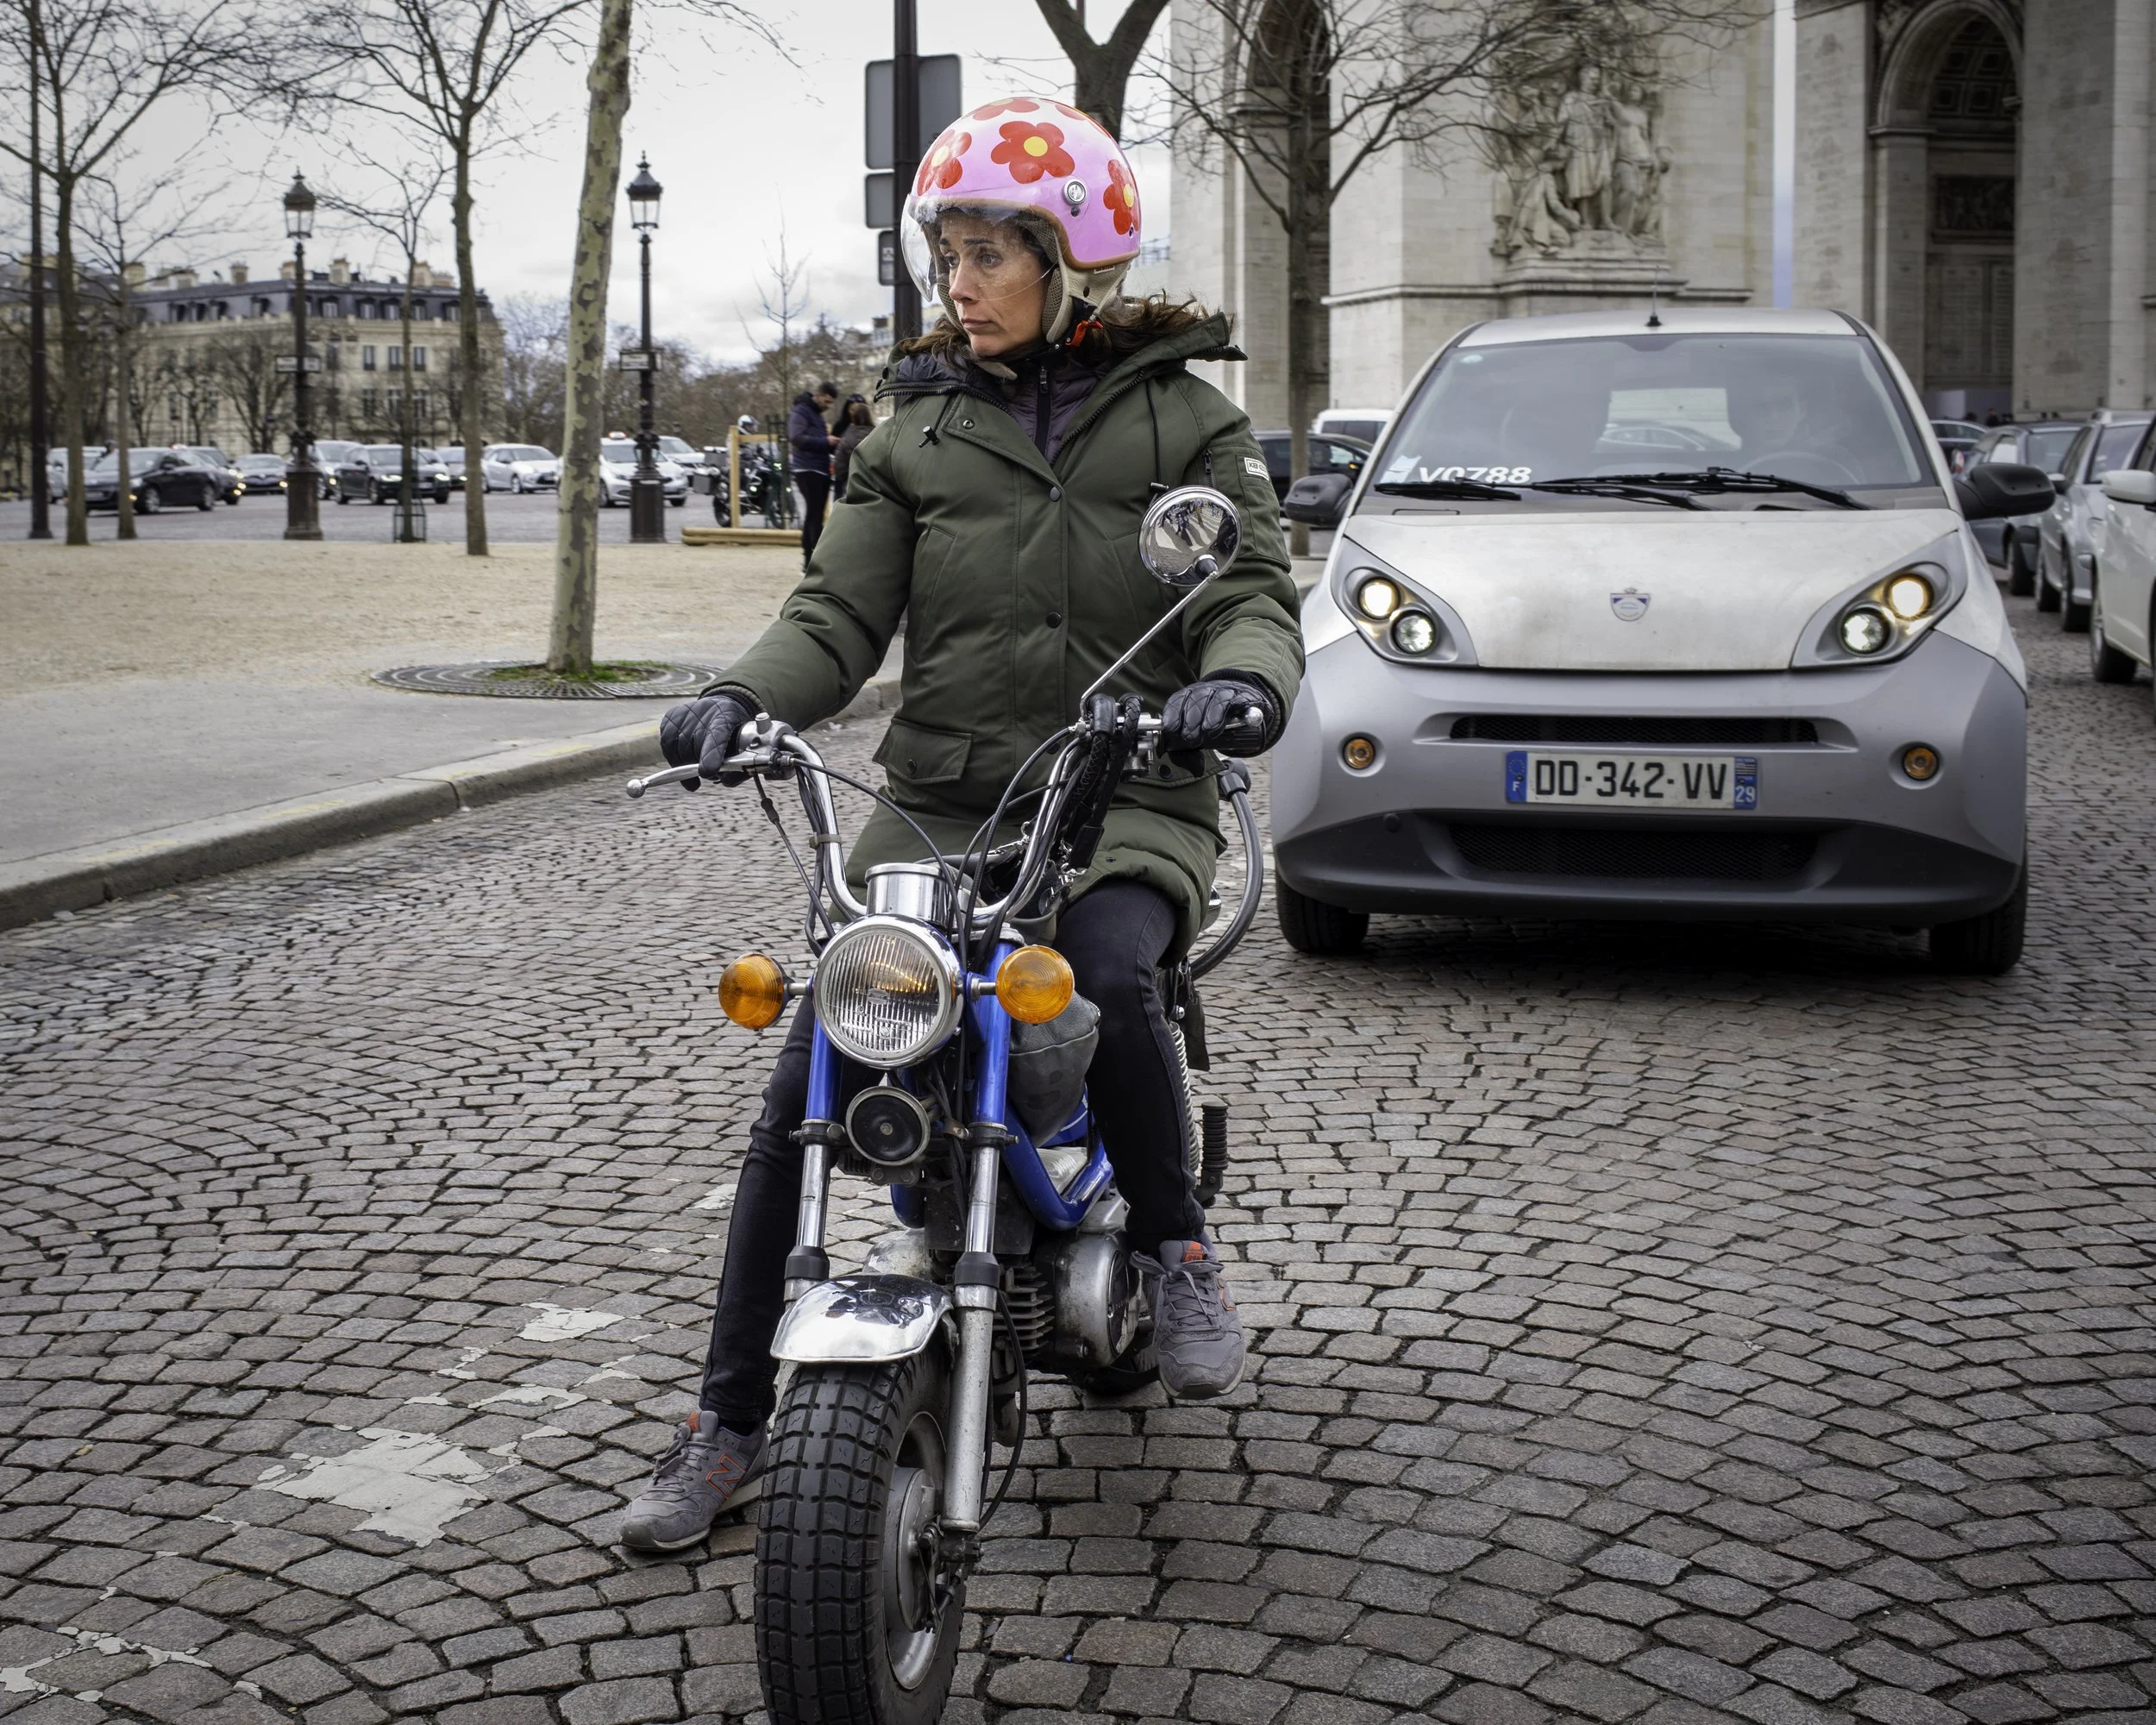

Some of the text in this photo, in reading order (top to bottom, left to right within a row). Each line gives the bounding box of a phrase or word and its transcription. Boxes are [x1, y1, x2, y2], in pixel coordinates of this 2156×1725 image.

[1513, 781, 1520, 792] F
[1535, 760, 1727, 800] DD-342-VV
[1735, 786, 1756, 803] 29
